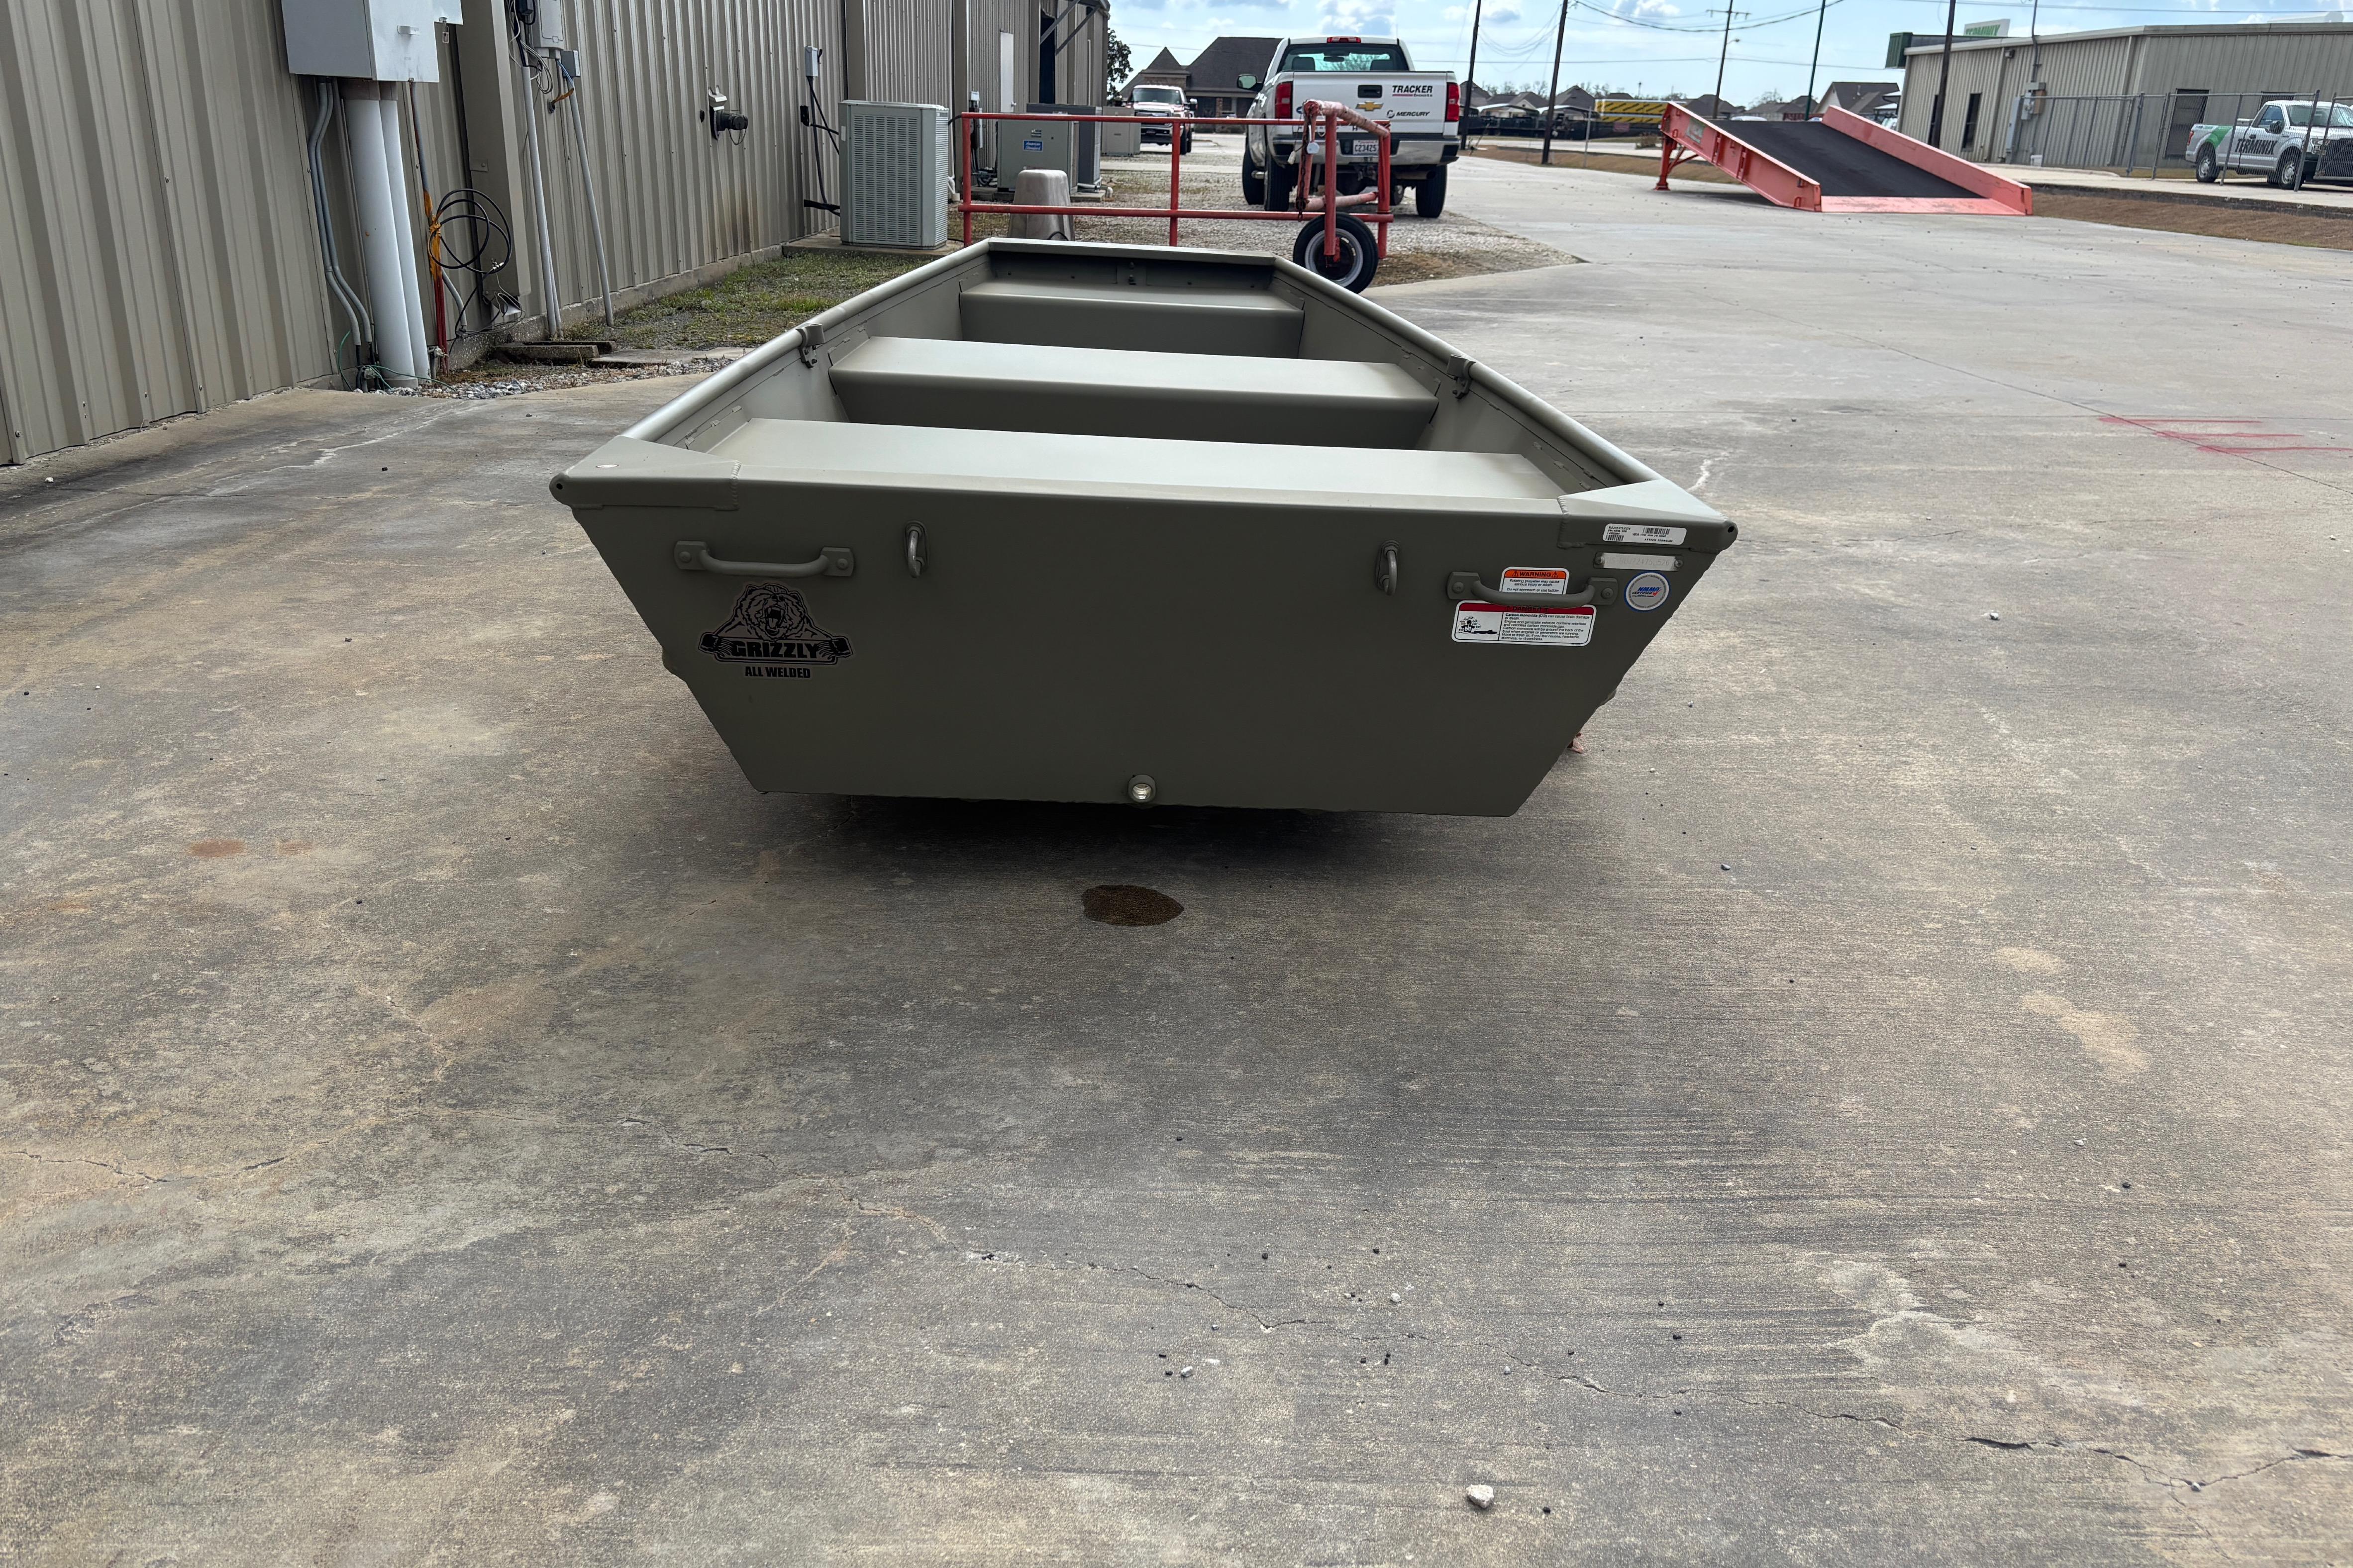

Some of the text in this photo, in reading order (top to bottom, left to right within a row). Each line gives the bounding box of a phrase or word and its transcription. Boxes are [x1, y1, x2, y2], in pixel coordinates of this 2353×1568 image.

[2235, 139, 2277, 155] TERMINIX
[731, 640, 819, 659] GRIZZLY
[745, 666, 811, 679] ALL WELDED
